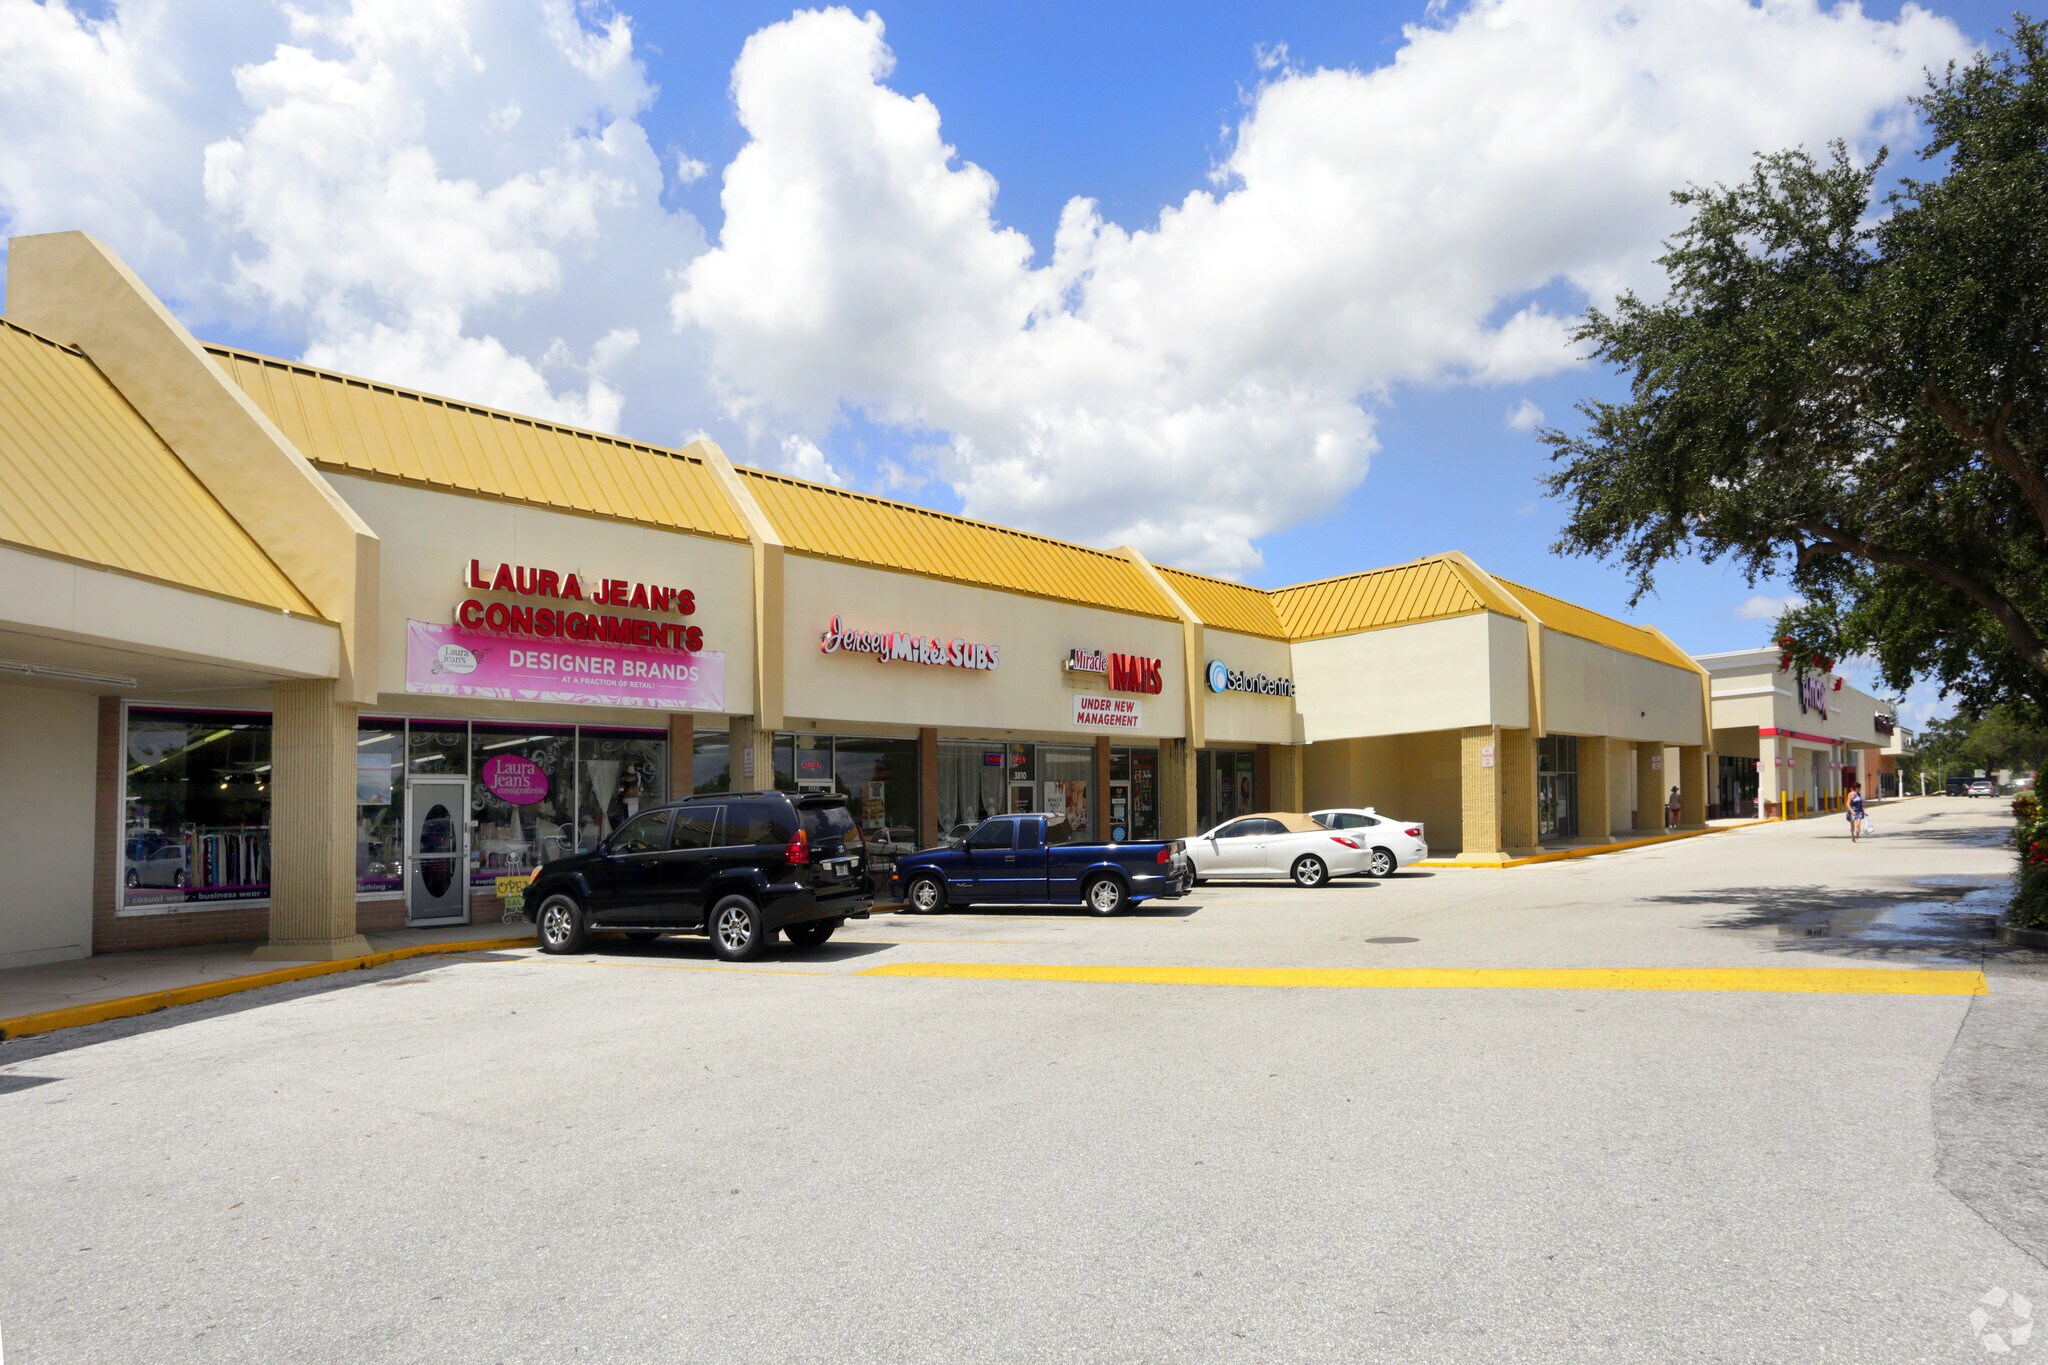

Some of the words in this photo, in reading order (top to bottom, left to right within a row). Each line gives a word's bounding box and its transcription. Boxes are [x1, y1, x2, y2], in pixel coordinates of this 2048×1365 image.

[467, 559, 583, 601] LAURA
[592, 578, 696, 615] JEAN'S
[458, 599, 704, 651] CONSIGNMENTS
[822, 615, 889, 663] Jersey
[890, 631, 949, 665] Mike's
[949, 637, 1000, 671] SUBS
[445, 646, 469, 657] Laura
[509, 650, 616, 676] DESIGNER
[622, 659, 700, 682] BRANDS
[1074, 648, 1107, 672] Miracle
[1108, 652, 1162, 695] NAILS
[580, 677, 617, 687] FRACTION
[629, 681, 655, 689] RETAIL!
[1081, 697, 1111, 712] UNDER
[1114, 700, 1134, 713] NEW
[1077, 711, 1138, 727] MANAGEMENT
[496, 759, 535, 775] Laura
[801, 760, 823, 769] OPEN
[1011, 754, 1028, 764] OPEN
[490, 773, 530, 789] Jean's
[498, 786, 545, 796] consignments
[132, 894, 163, 904] casual
[166, 894, 190, 902] wear
[198, 891, 237, 900] business
